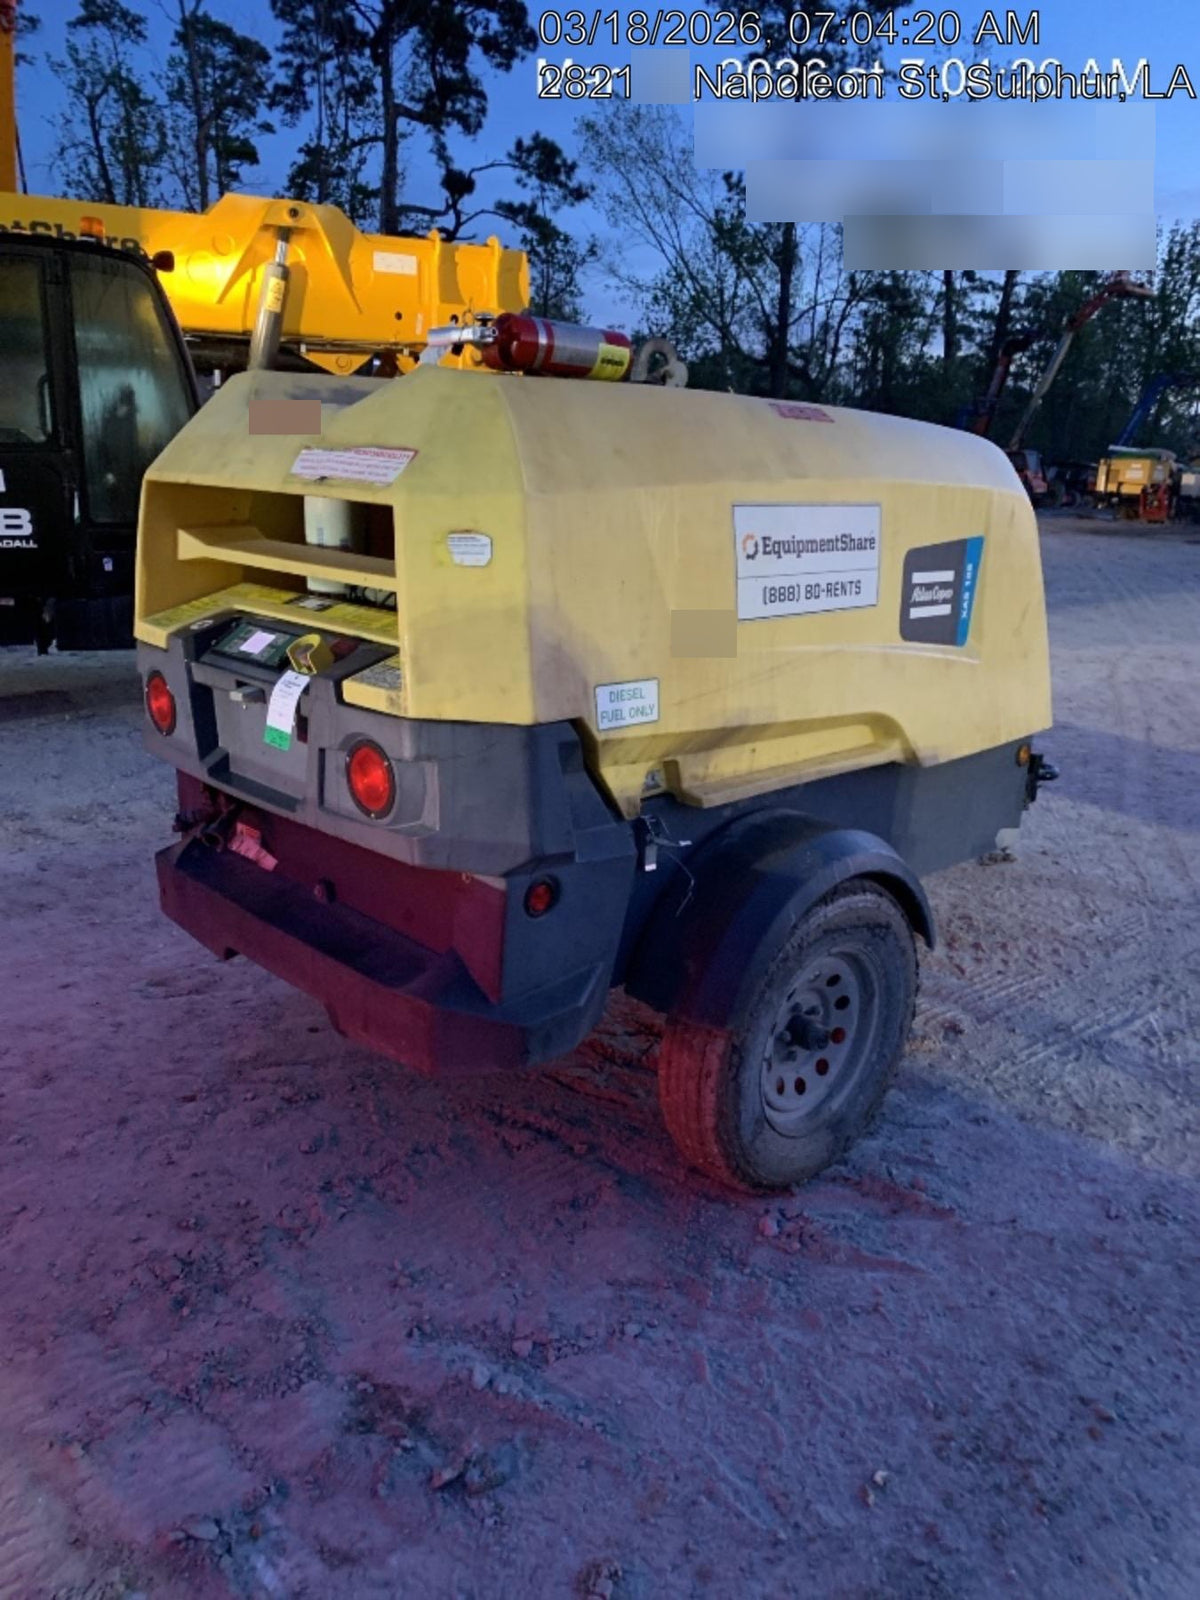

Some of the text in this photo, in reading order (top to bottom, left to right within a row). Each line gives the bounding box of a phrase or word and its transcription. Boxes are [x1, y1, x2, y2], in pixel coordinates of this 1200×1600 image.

[761, 533, 876, 559] EquipmentShare
[762, 584, 800, 605] (888)
[608, 687, 646, 703] DIESEL
[600, 703, 655, 724] FUEL ONLY
